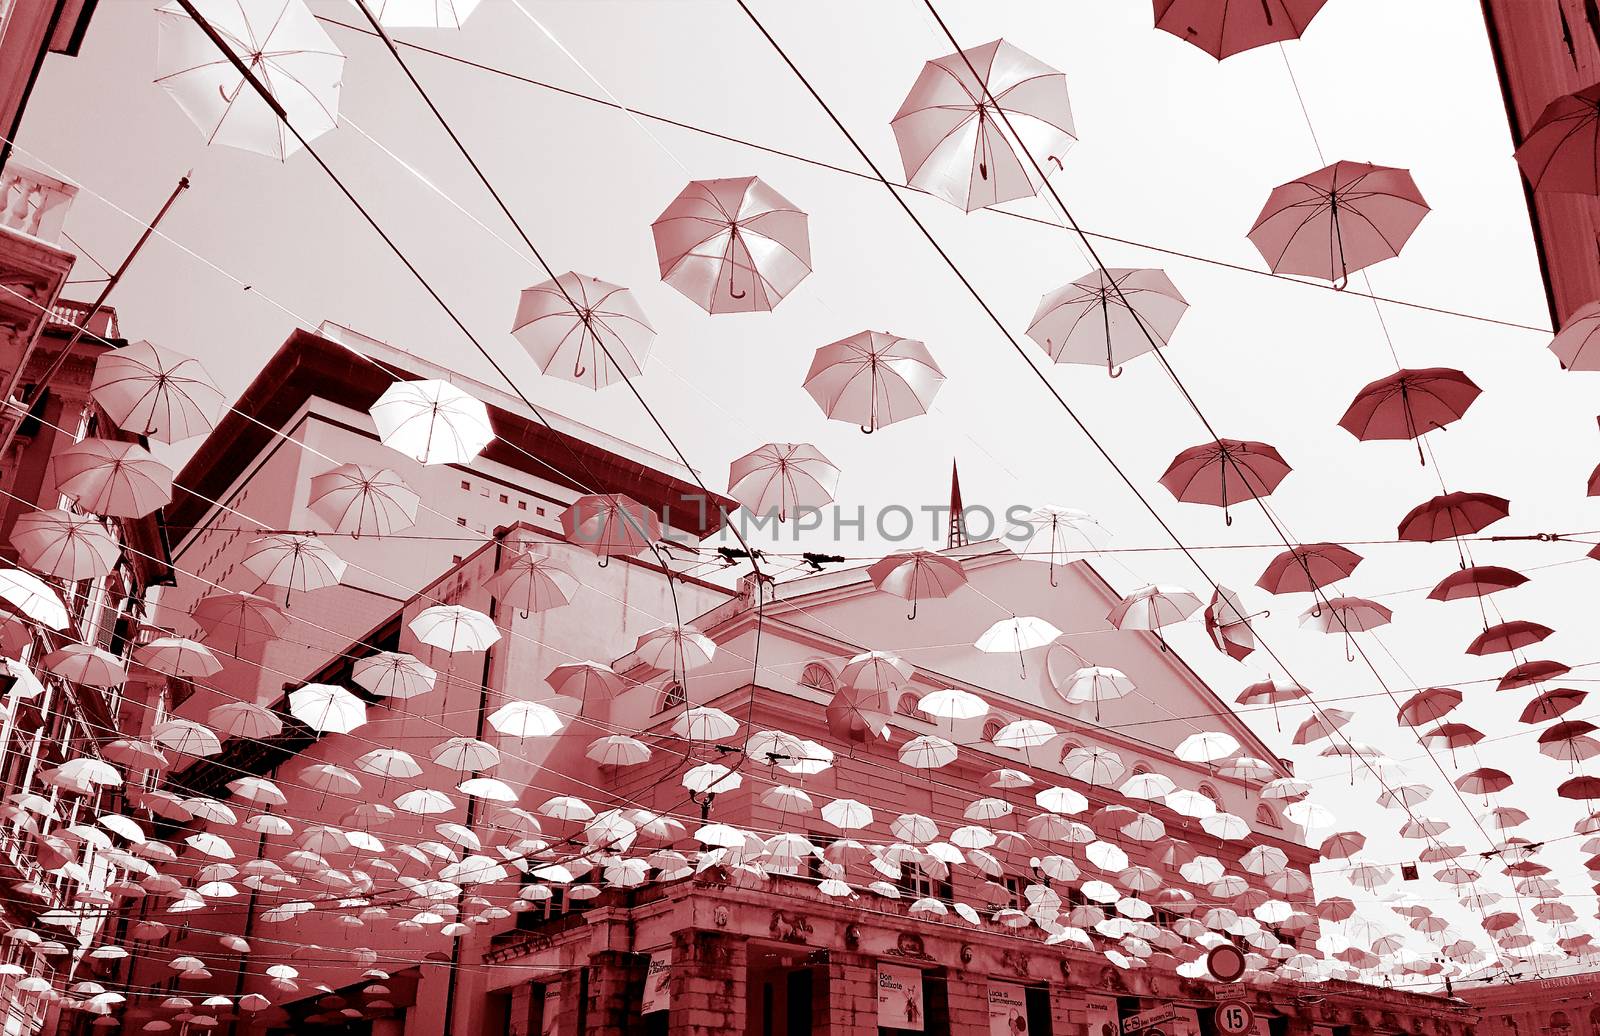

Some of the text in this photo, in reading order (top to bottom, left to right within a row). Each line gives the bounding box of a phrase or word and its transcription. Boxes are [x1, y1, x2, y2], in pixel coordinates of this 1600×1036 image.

[879, 972, 893, 981] Don
[879, 979, 903, 991] Quixote
[989, 988, 1003, 997] Lucia
[989, 997, 1023, 1007] Lammermoor
[1149, 1014, 1165, 1023] Western
[1164, 1010, 1174, 1018] City
[1226, 1009, 1243, 1029] 15
